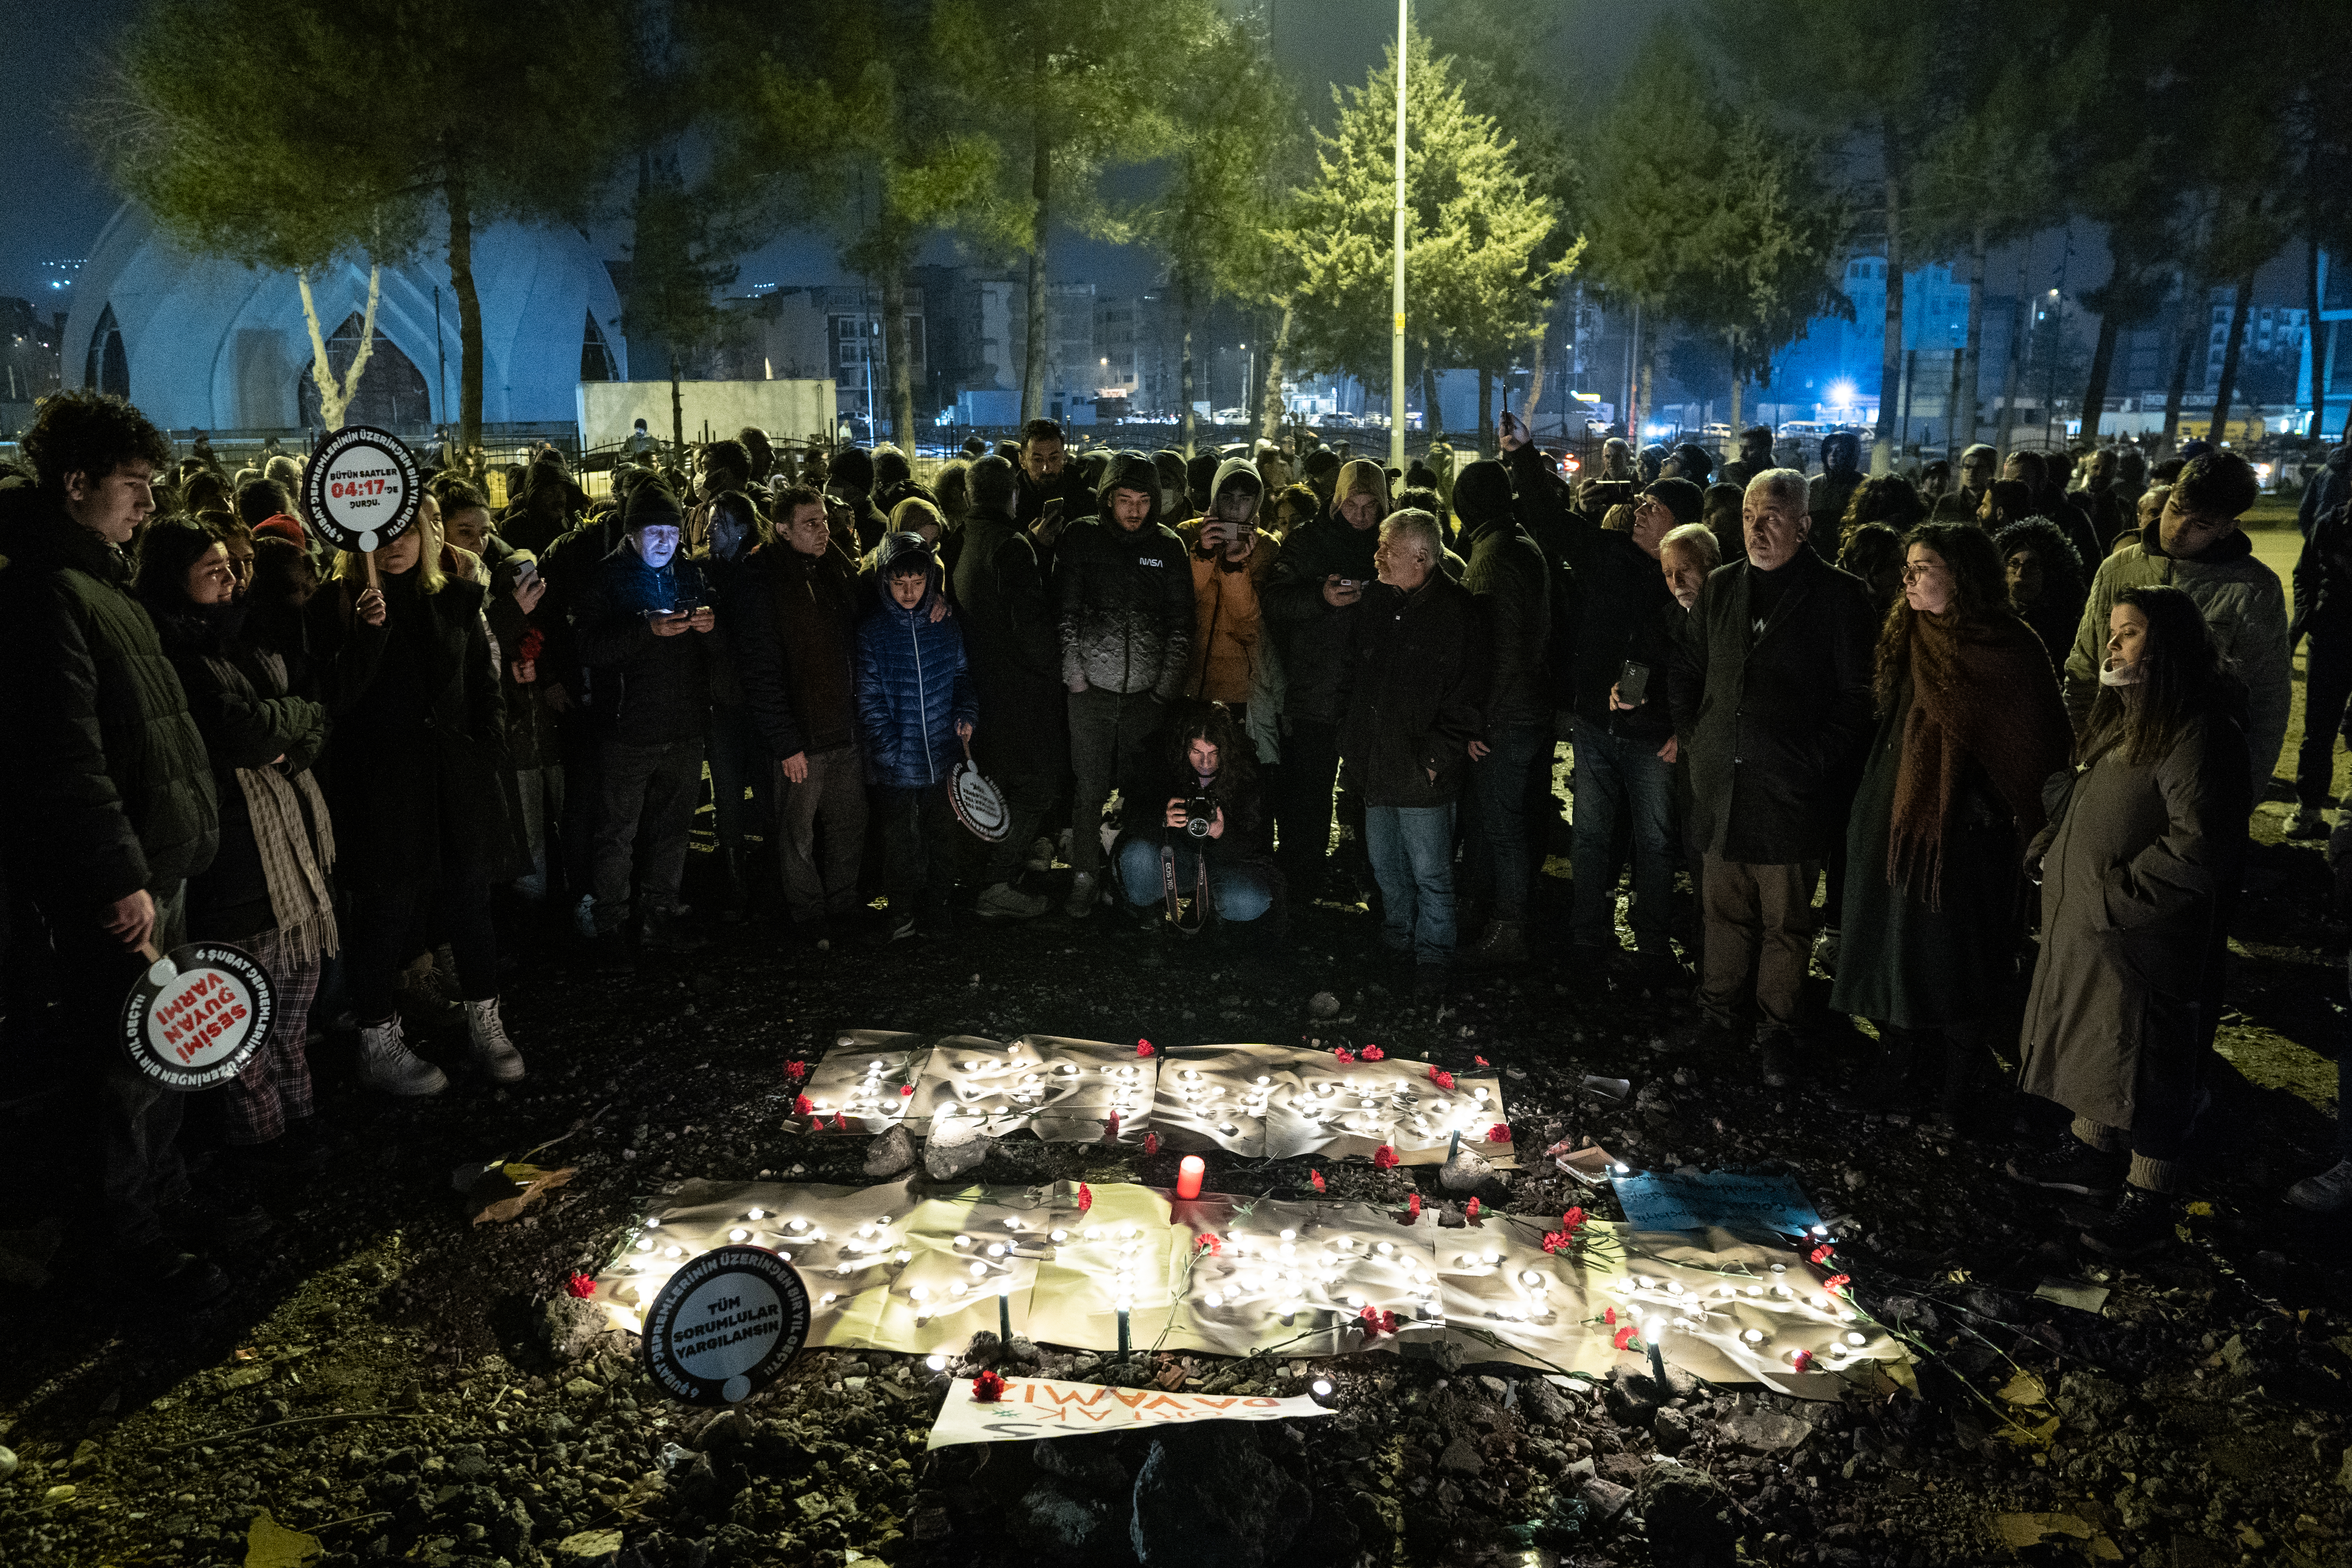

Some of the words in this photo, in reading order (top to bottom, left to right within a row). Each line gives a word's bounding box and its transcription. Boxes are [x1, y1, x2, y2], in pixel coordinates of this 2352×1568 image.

[360, 429, 413, 468] ÜZERİNDEN
[330, 470, 358, 481] BÜTÜN
[359, 468, 398, 478] SAATLER
[407, 468, 420, 487] BİR
[350, 499, 380, 509] DURDU.
[408, 489, 419, 505] YIL
[312, 506, 337, 538] ŞUBAT
[336, 533, 344, 542] 6
[1139, 557, 1163, 568] NASA
[196, 949, 205, 960] 6
[208, 949, 252, 970] ŞUBAT
[163, 986, 236, 1045] DUYAN
[176, 1004, 247, 1064] SESİMİ
[129, 1037, 145, 1060] YIL
[139, 1056, 162, 1077] BİR
[720, 1252, 795, 1288] ÜZERİNDEN
[708, 1296, 741, 1315] TÜM
[787, 1287, 805, 1313] BİR
[673, 1304, 779, 1342] SORUMLULAR
[790, 1313, 804, 1333] YIL
[675, 1320, 780, 1359] YARGILANSIN
[655, 1362, 690, 1395] ŞUBAT
[689, 1387, 700, 1398] 6
